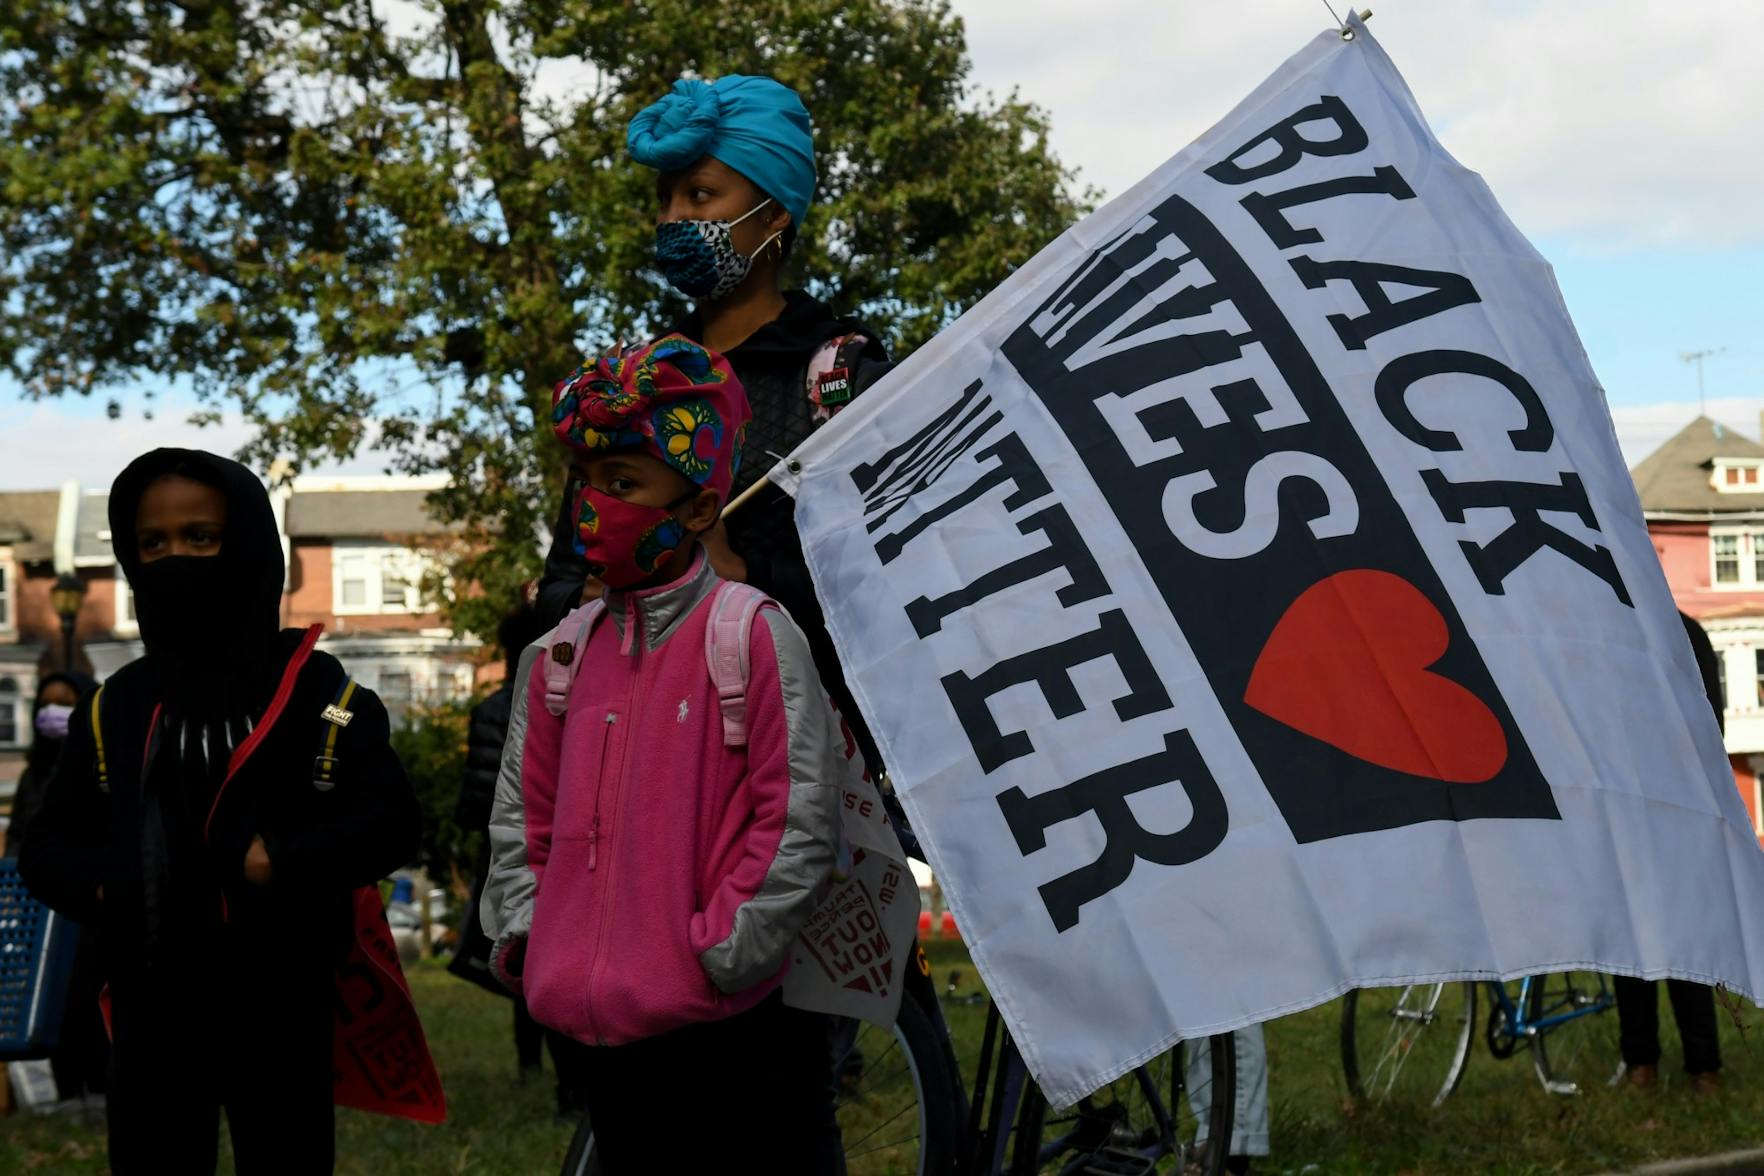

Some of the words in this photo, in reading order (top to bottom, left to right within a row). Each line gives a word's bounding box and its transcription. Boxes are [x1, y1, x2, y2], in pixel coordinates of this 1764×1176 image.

[821, 379, 848, 393] LIVES
[1028, 213, 1361, 561] LIVES
[1203, 95, 1636, 610] BLACK
[326, 705, 352, 721] FIGHT
